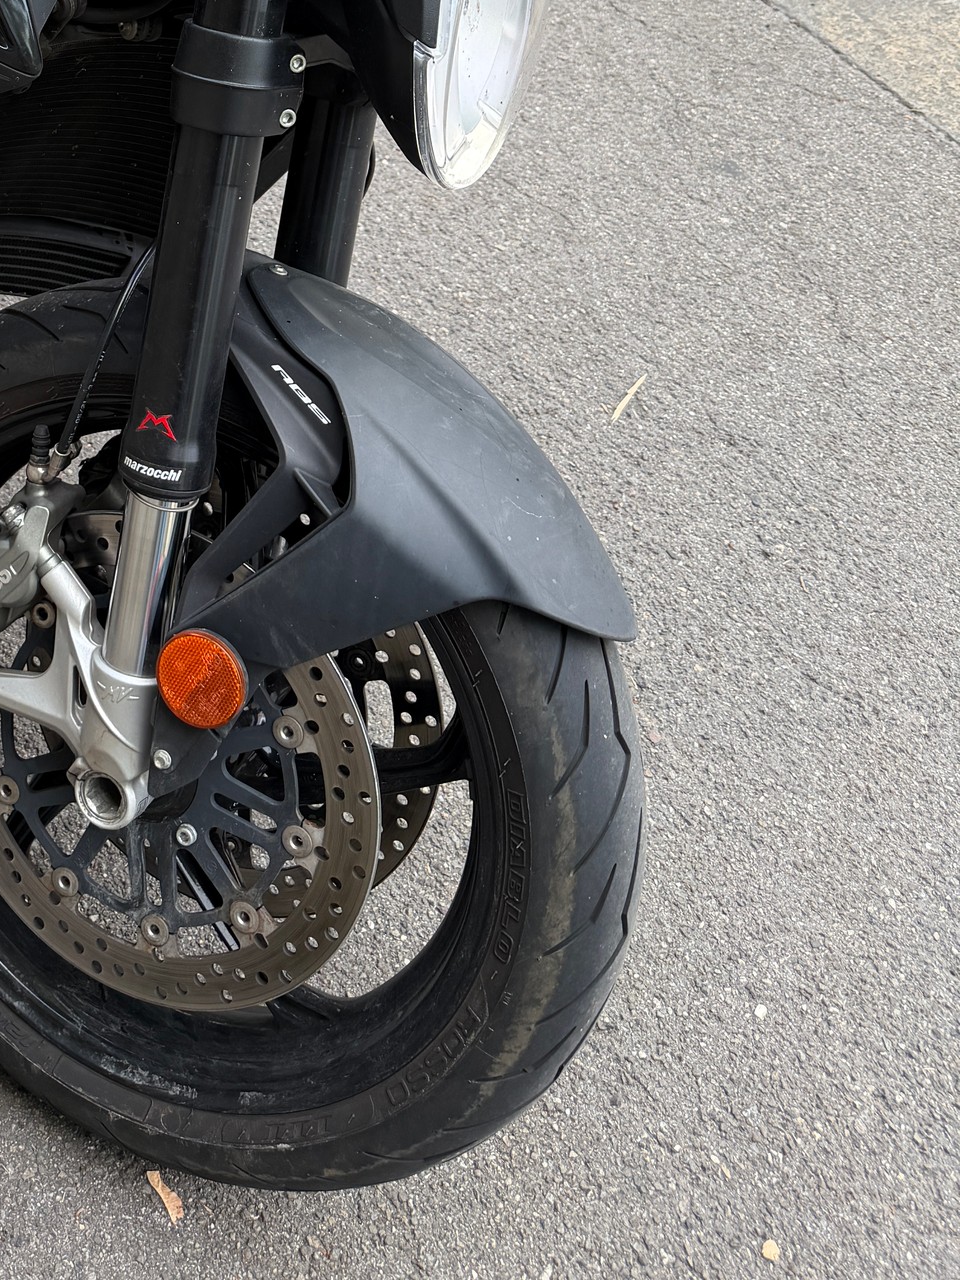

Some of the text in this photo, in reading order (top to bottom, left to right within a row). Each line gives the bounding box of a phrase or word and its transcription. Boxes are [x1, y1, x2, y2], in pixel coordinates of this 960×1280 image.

[271, 364, 332, 425] ABS
[123, 455, 183, 483] marzocchi
[493, 788, 527, 966] DIABLO
[384, 1004, 483, 1108] ROSSO
